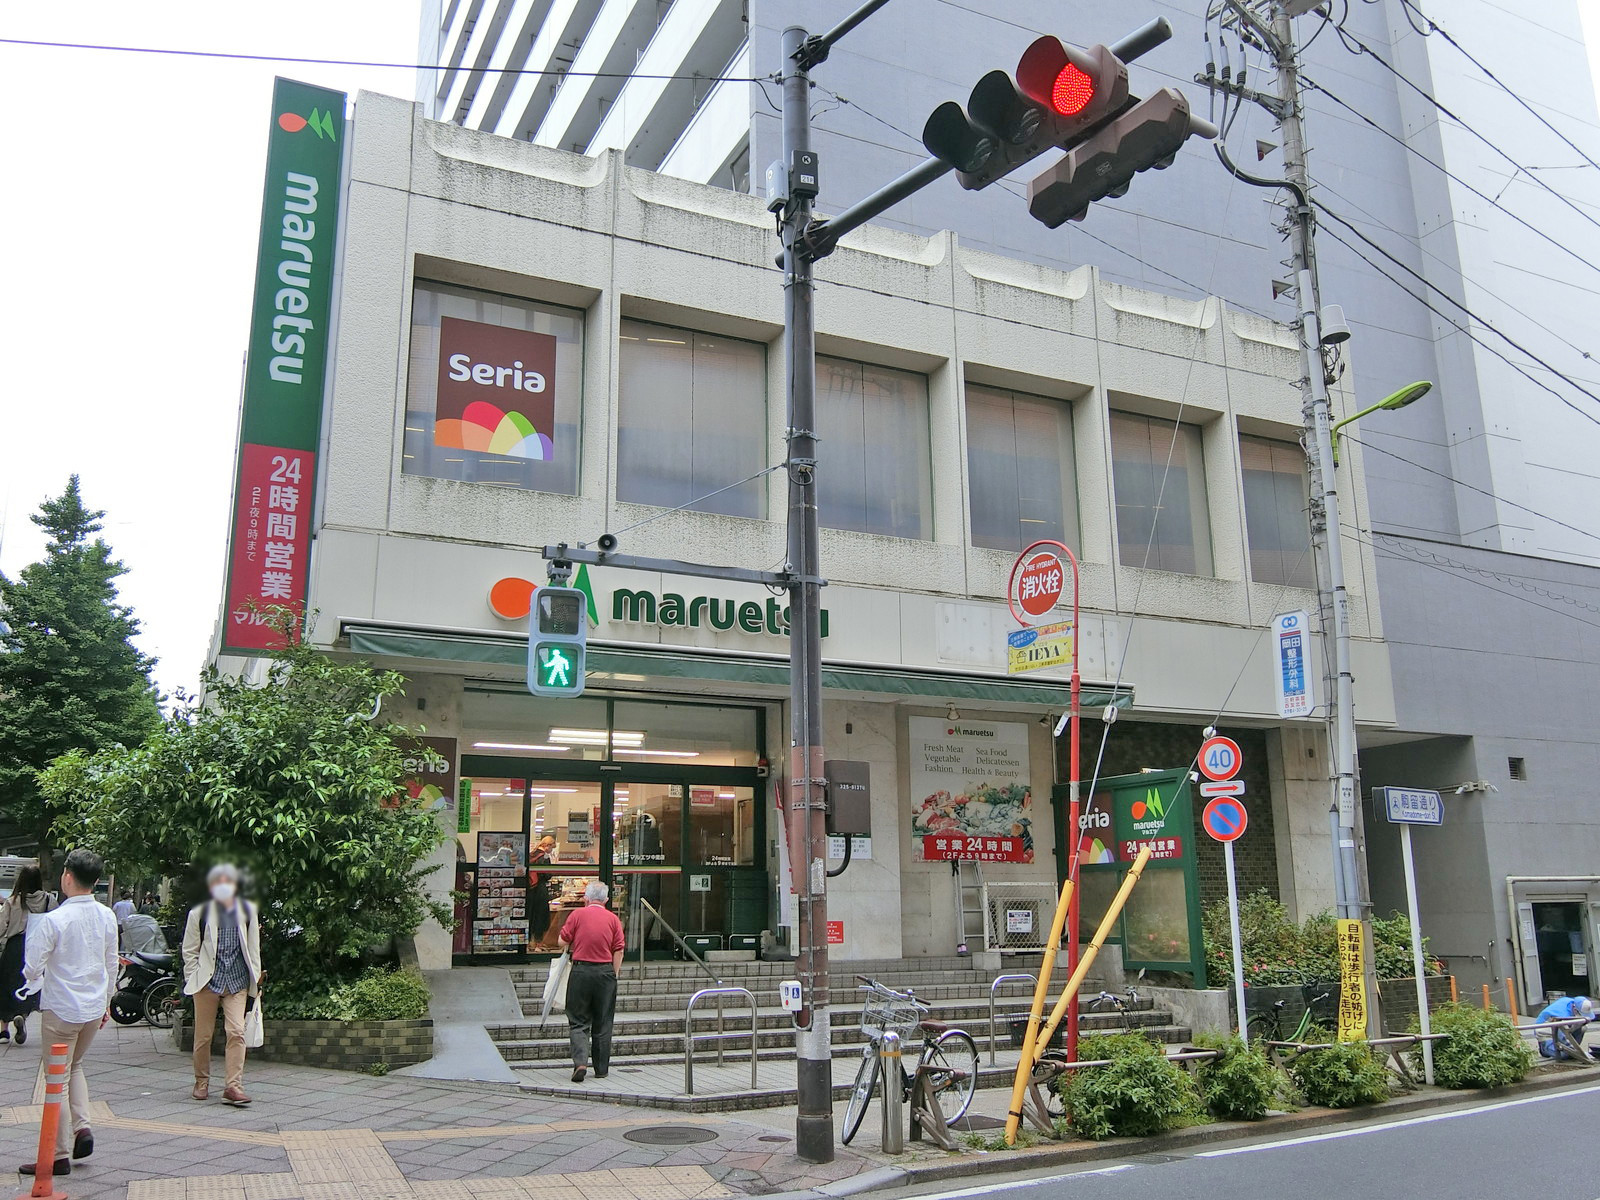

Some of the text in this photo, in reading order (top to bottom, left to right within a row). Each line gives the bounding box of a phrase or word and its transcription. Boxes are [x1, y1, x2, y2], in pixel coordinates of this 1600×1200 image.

[269, 171, 319, 385] maruetsu
[448, 353, 546, 394] Seria
[260, 455, 302, 600] 24時間営業
[1025, 562, 1036, 573] FIRE
[1022, 569, 1060, 600] 消火栓
[612, 588, 829, 639] maruet
[1028, 645, 1060, 662] IEYA
[1287, 648, 1299, 689] 整形外科
[962, 729, 994, 737] maruetsu
[924, 744, 964, 753] Fresh Meat
[975, 748, 1008, 757] Sea Food
[403, 757, 450, 774] eria
[924, 754, 961, 763] Vegetable
[976, 757, 1020, 767] Delicatessen
[1208, 749, 1231, 769] 40
[924, 764, 954, 773] Fashion
[962, 766, 986, 776] Health
[995, 768, 1019, 778] Beauty
[1401, 793, 1437, 810] 駒留通り
[1133, 820, 1165, 831] maruetsu
[1347, 923, 1364, 1030] 自転車は歩行者の妨げに
